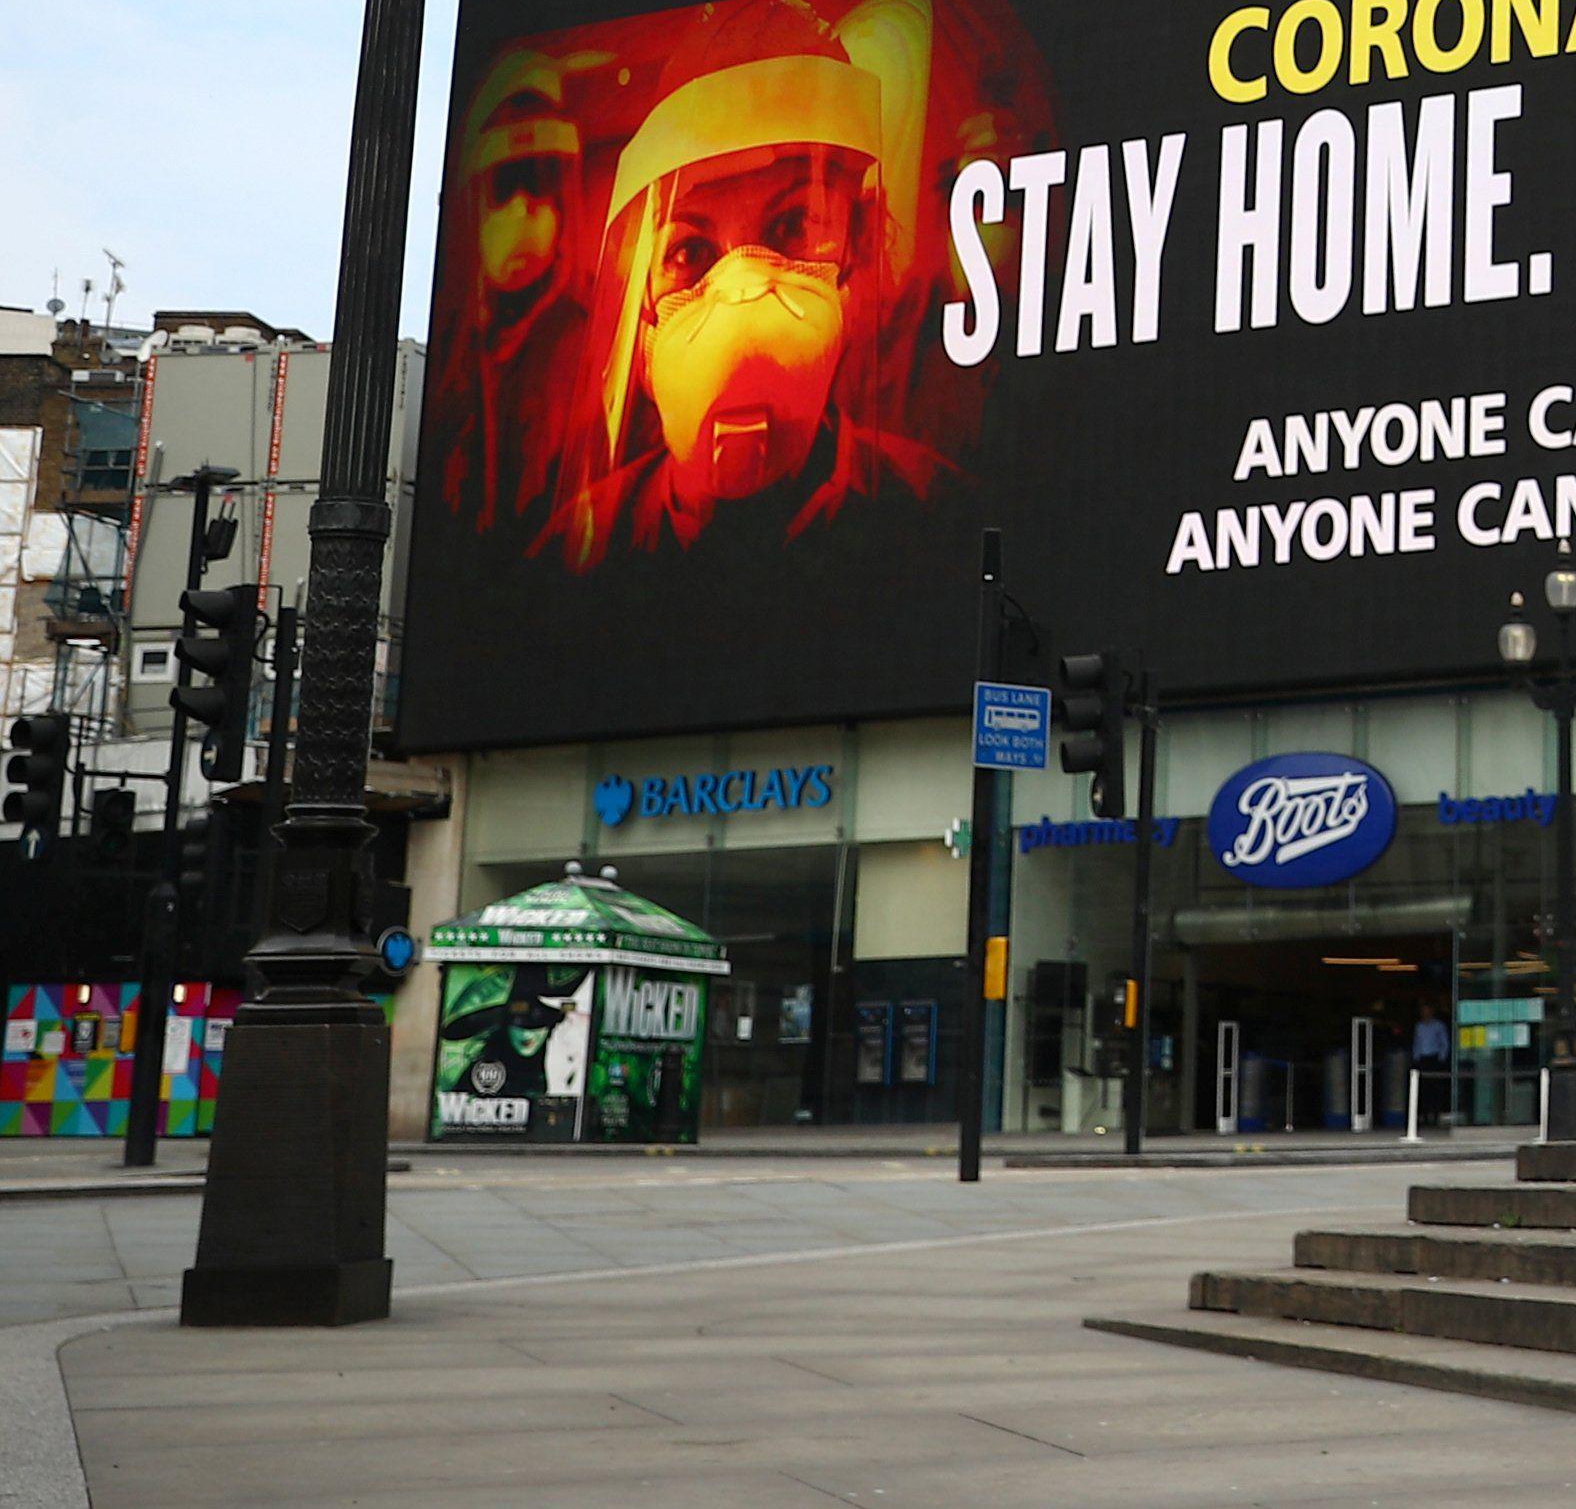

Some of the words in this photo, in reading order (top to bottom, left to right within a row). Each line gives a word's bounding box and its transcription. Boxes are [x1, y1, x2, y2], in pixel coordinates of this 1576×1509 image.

[941, 132, 1186, 367] STAY
[1213, 83, 1553, 334] HOME.
[1233, 392, 1507, 481] ANYONE
[1166, 488, 1436, 574] ANYONE
[984, 688, 1010, 703] BUS
[1011, 691, 1041, 706] LANE
[978, 733, 1009, 748] LOOK
[1011, 734, 1045, 749] BOTH
[640, 765, 834, 818] BARCLAYS
[1222, 771, 1369, 866] Boots
[1438, 788, 1557, 827] beauty
